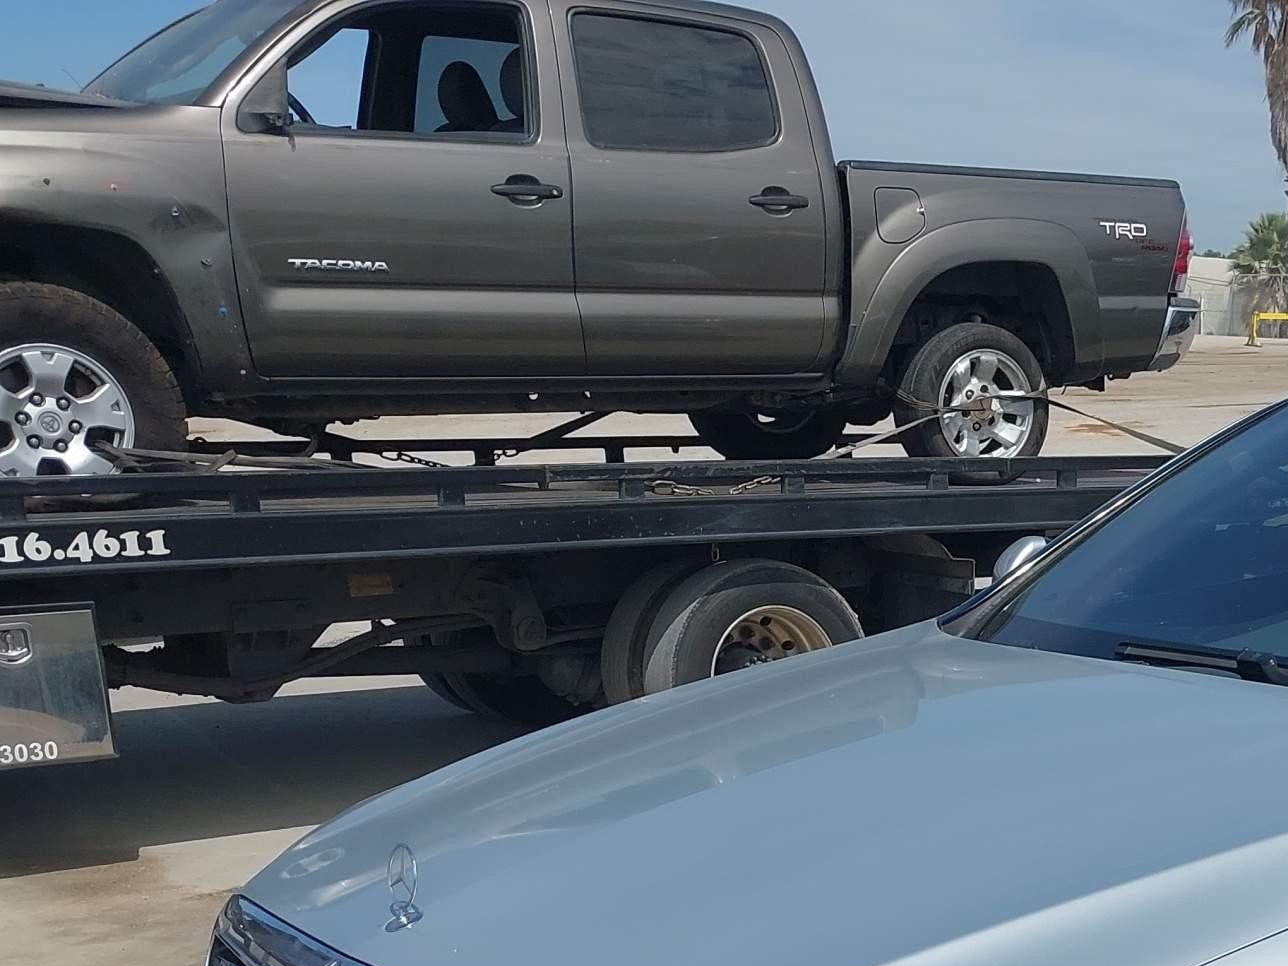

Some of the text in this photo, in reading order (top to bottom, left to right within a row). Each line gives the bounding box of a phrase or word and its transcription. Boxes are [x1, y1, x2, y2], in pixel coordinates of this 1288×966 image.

[1099, 221, 1147, 240] TRD
[287, 258, 391, 272] TACOMA
[0, 529, 171, 563] 16.4611
[0, 740, 58, 764] 3030
